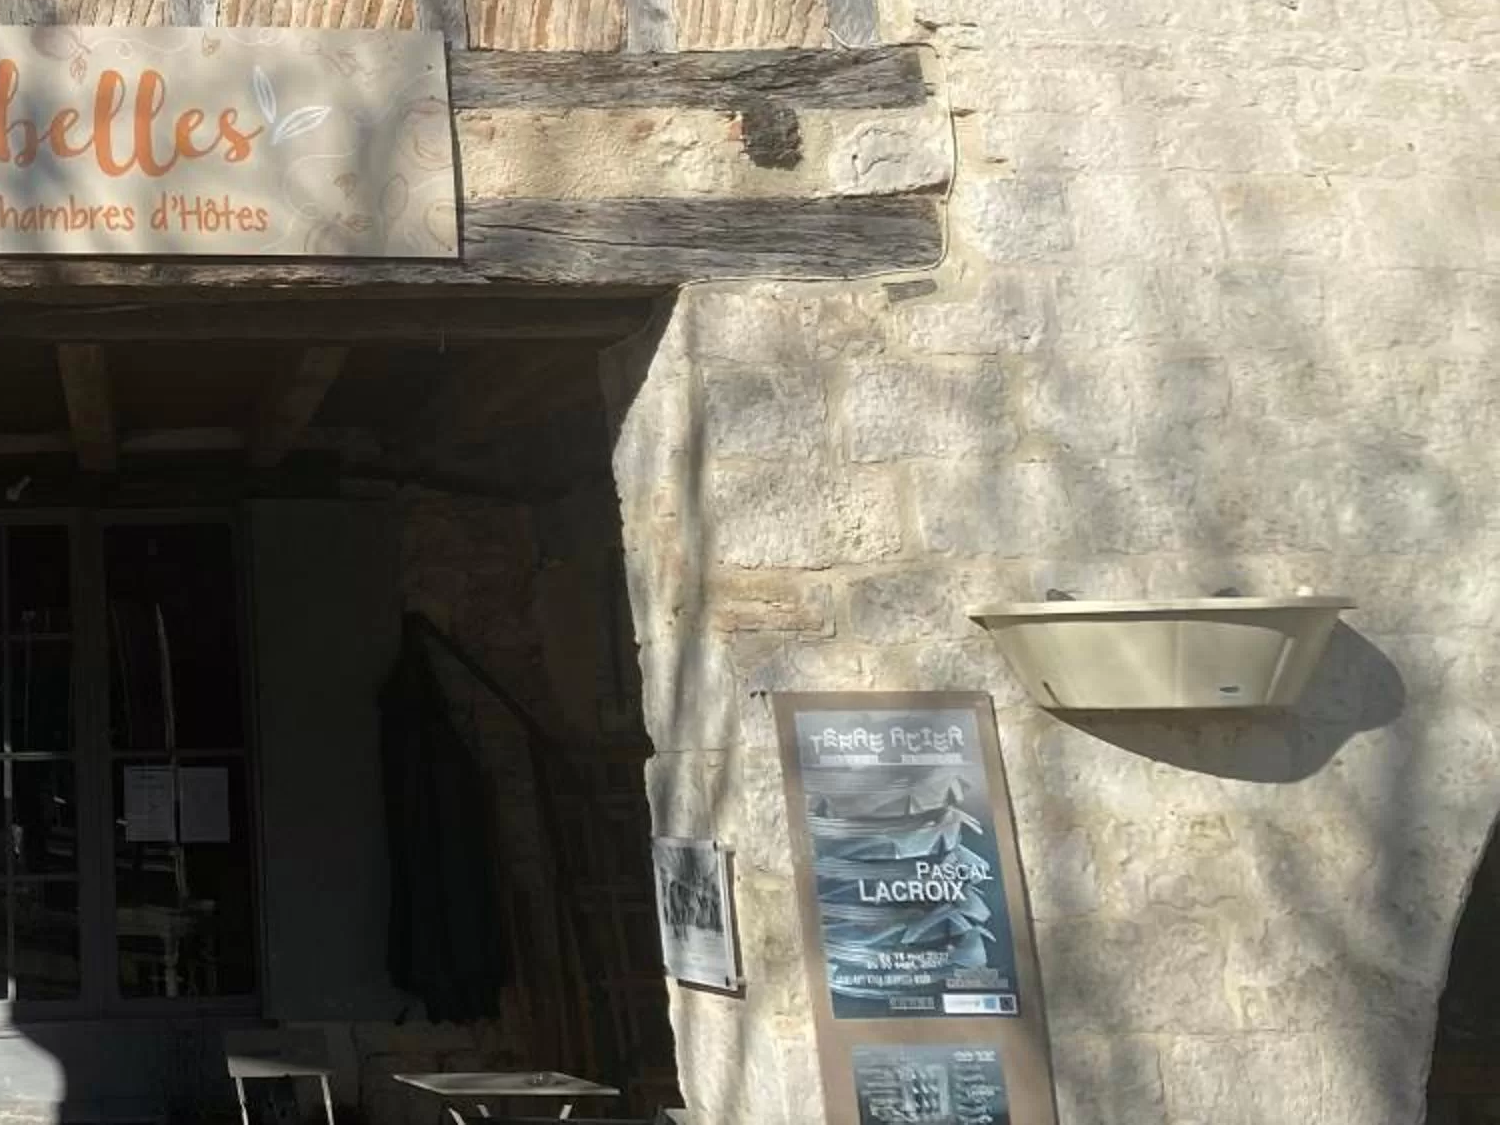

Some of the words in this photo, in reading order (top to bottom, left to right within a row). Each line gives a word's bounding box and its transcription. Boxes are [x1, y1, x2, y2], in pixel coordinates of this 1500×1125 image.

[150, 191, 268, 233] d'Hôtes
[808, 726, 885, 755] TERRE
[887, 724, 965, 753] ACIER
[915, 861, 993, 882] PASCAL
[858, 877, 967, 905] LACROIX
